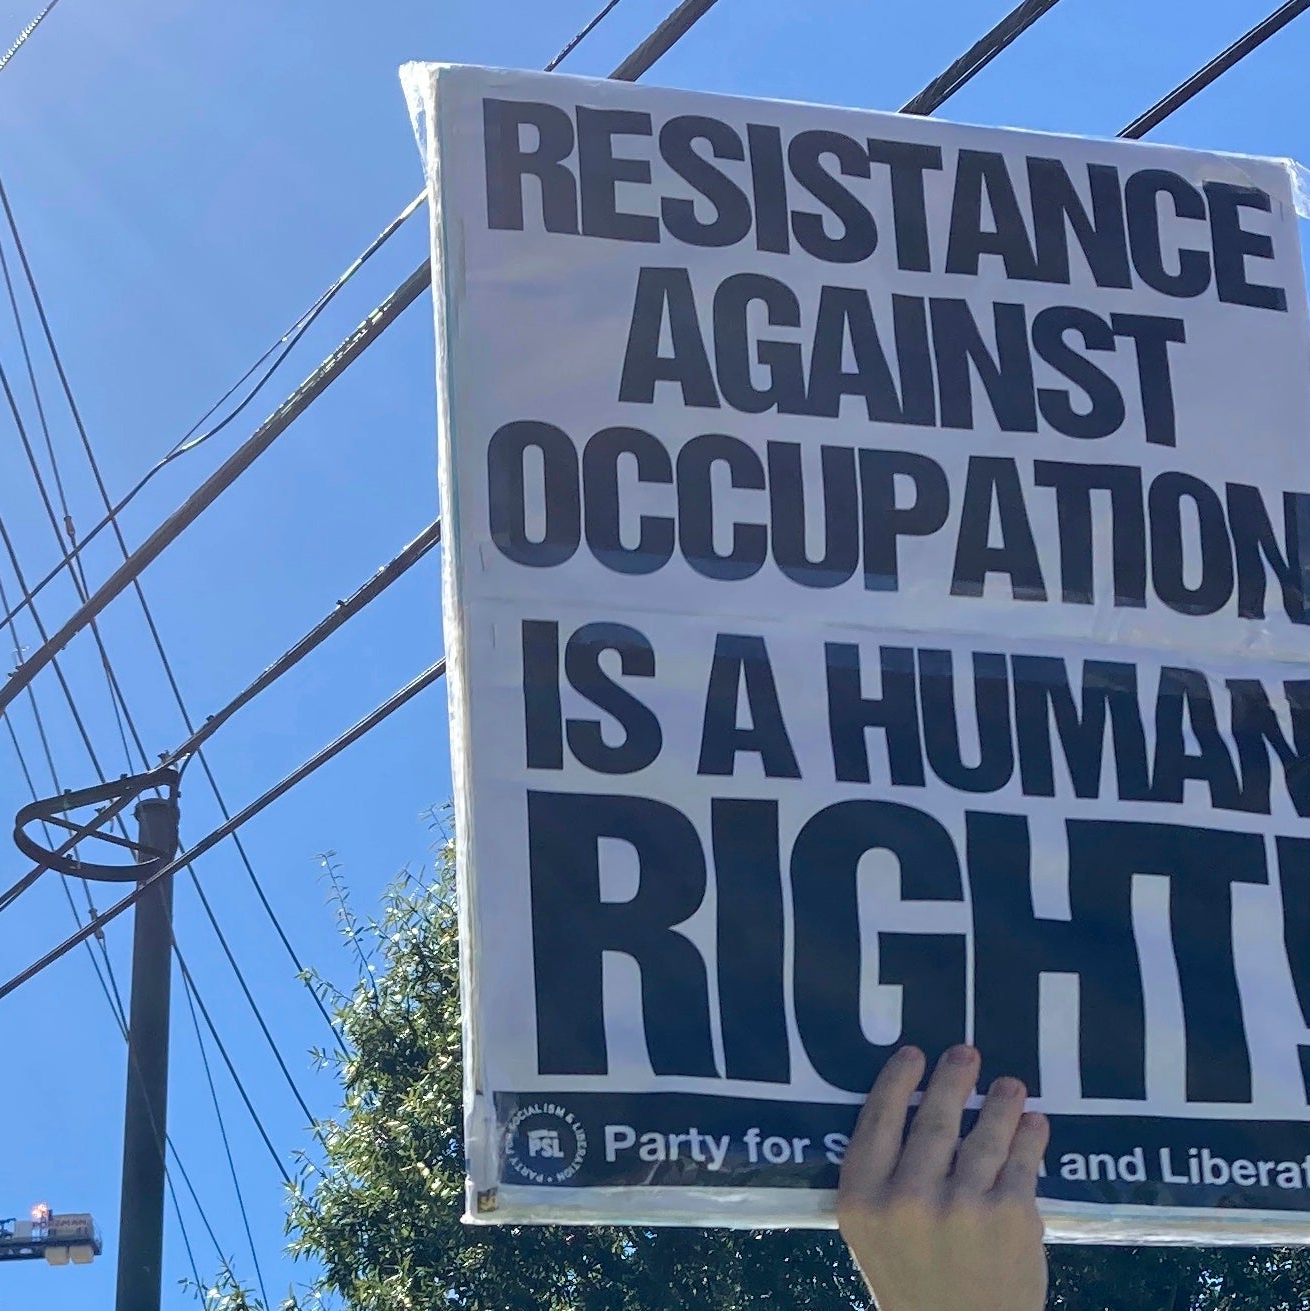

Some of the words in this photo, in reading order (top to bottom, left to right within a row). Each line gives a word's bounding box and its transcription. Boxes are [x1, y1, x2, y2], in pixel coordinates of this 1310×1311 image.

[482, 97, 1288, 313] RESISTANCE
[617, 265, 1186, 448] AGAINST
[521, 619, 663, 776] IS
[697, 633, 801, 780] A
[527, 1136, 565, 1159] PSL
[603, 1124, 731, 1172] Party
[742, 1127, 811, 1165] for
[1059, 1146, 1147, 1183] and
